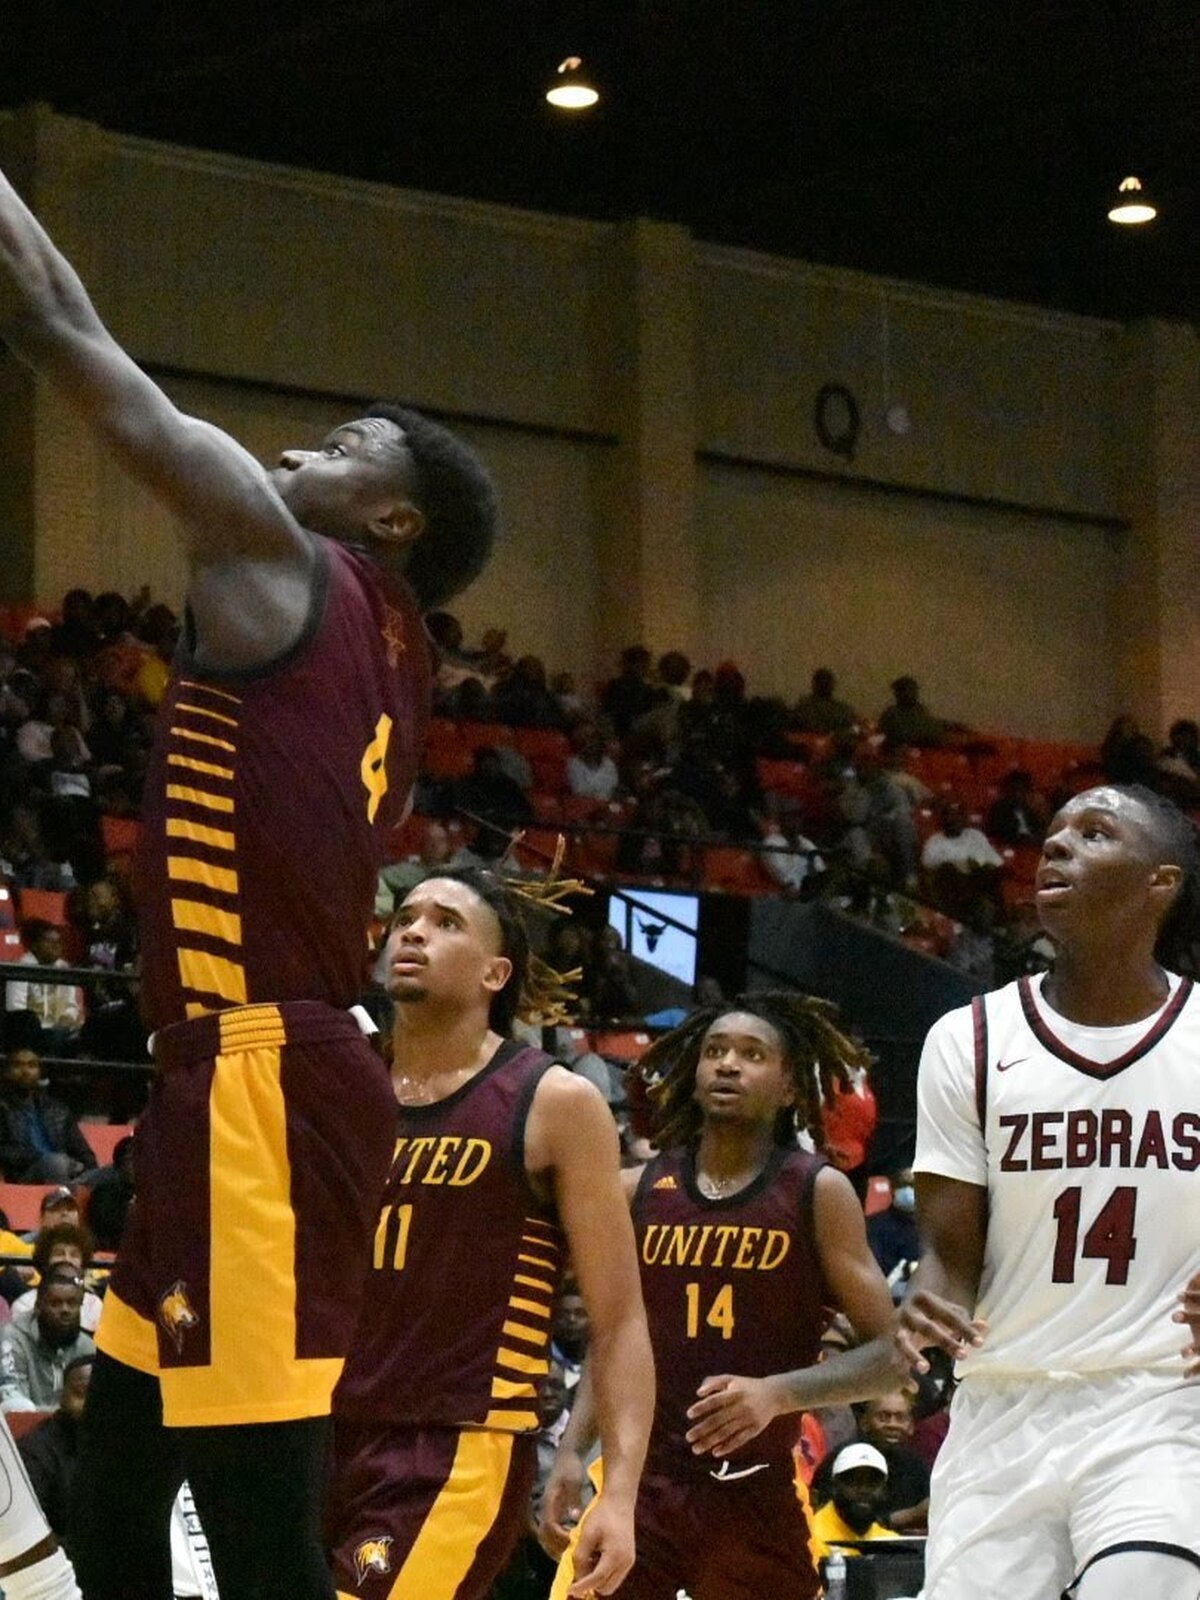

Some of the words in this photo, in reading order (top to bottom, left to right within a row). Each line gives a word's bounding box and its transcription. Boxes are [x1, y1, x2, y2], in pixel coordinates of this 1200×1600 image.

[999, 1108, 1200, 1172] ZEBRAS
[373, 1203, 413, 1270] 11
[642, 1224, 791, 1271] UNITED
[1052, 1186, 1138, 1286] 14
[685, 1282, 735, 1340] 14
